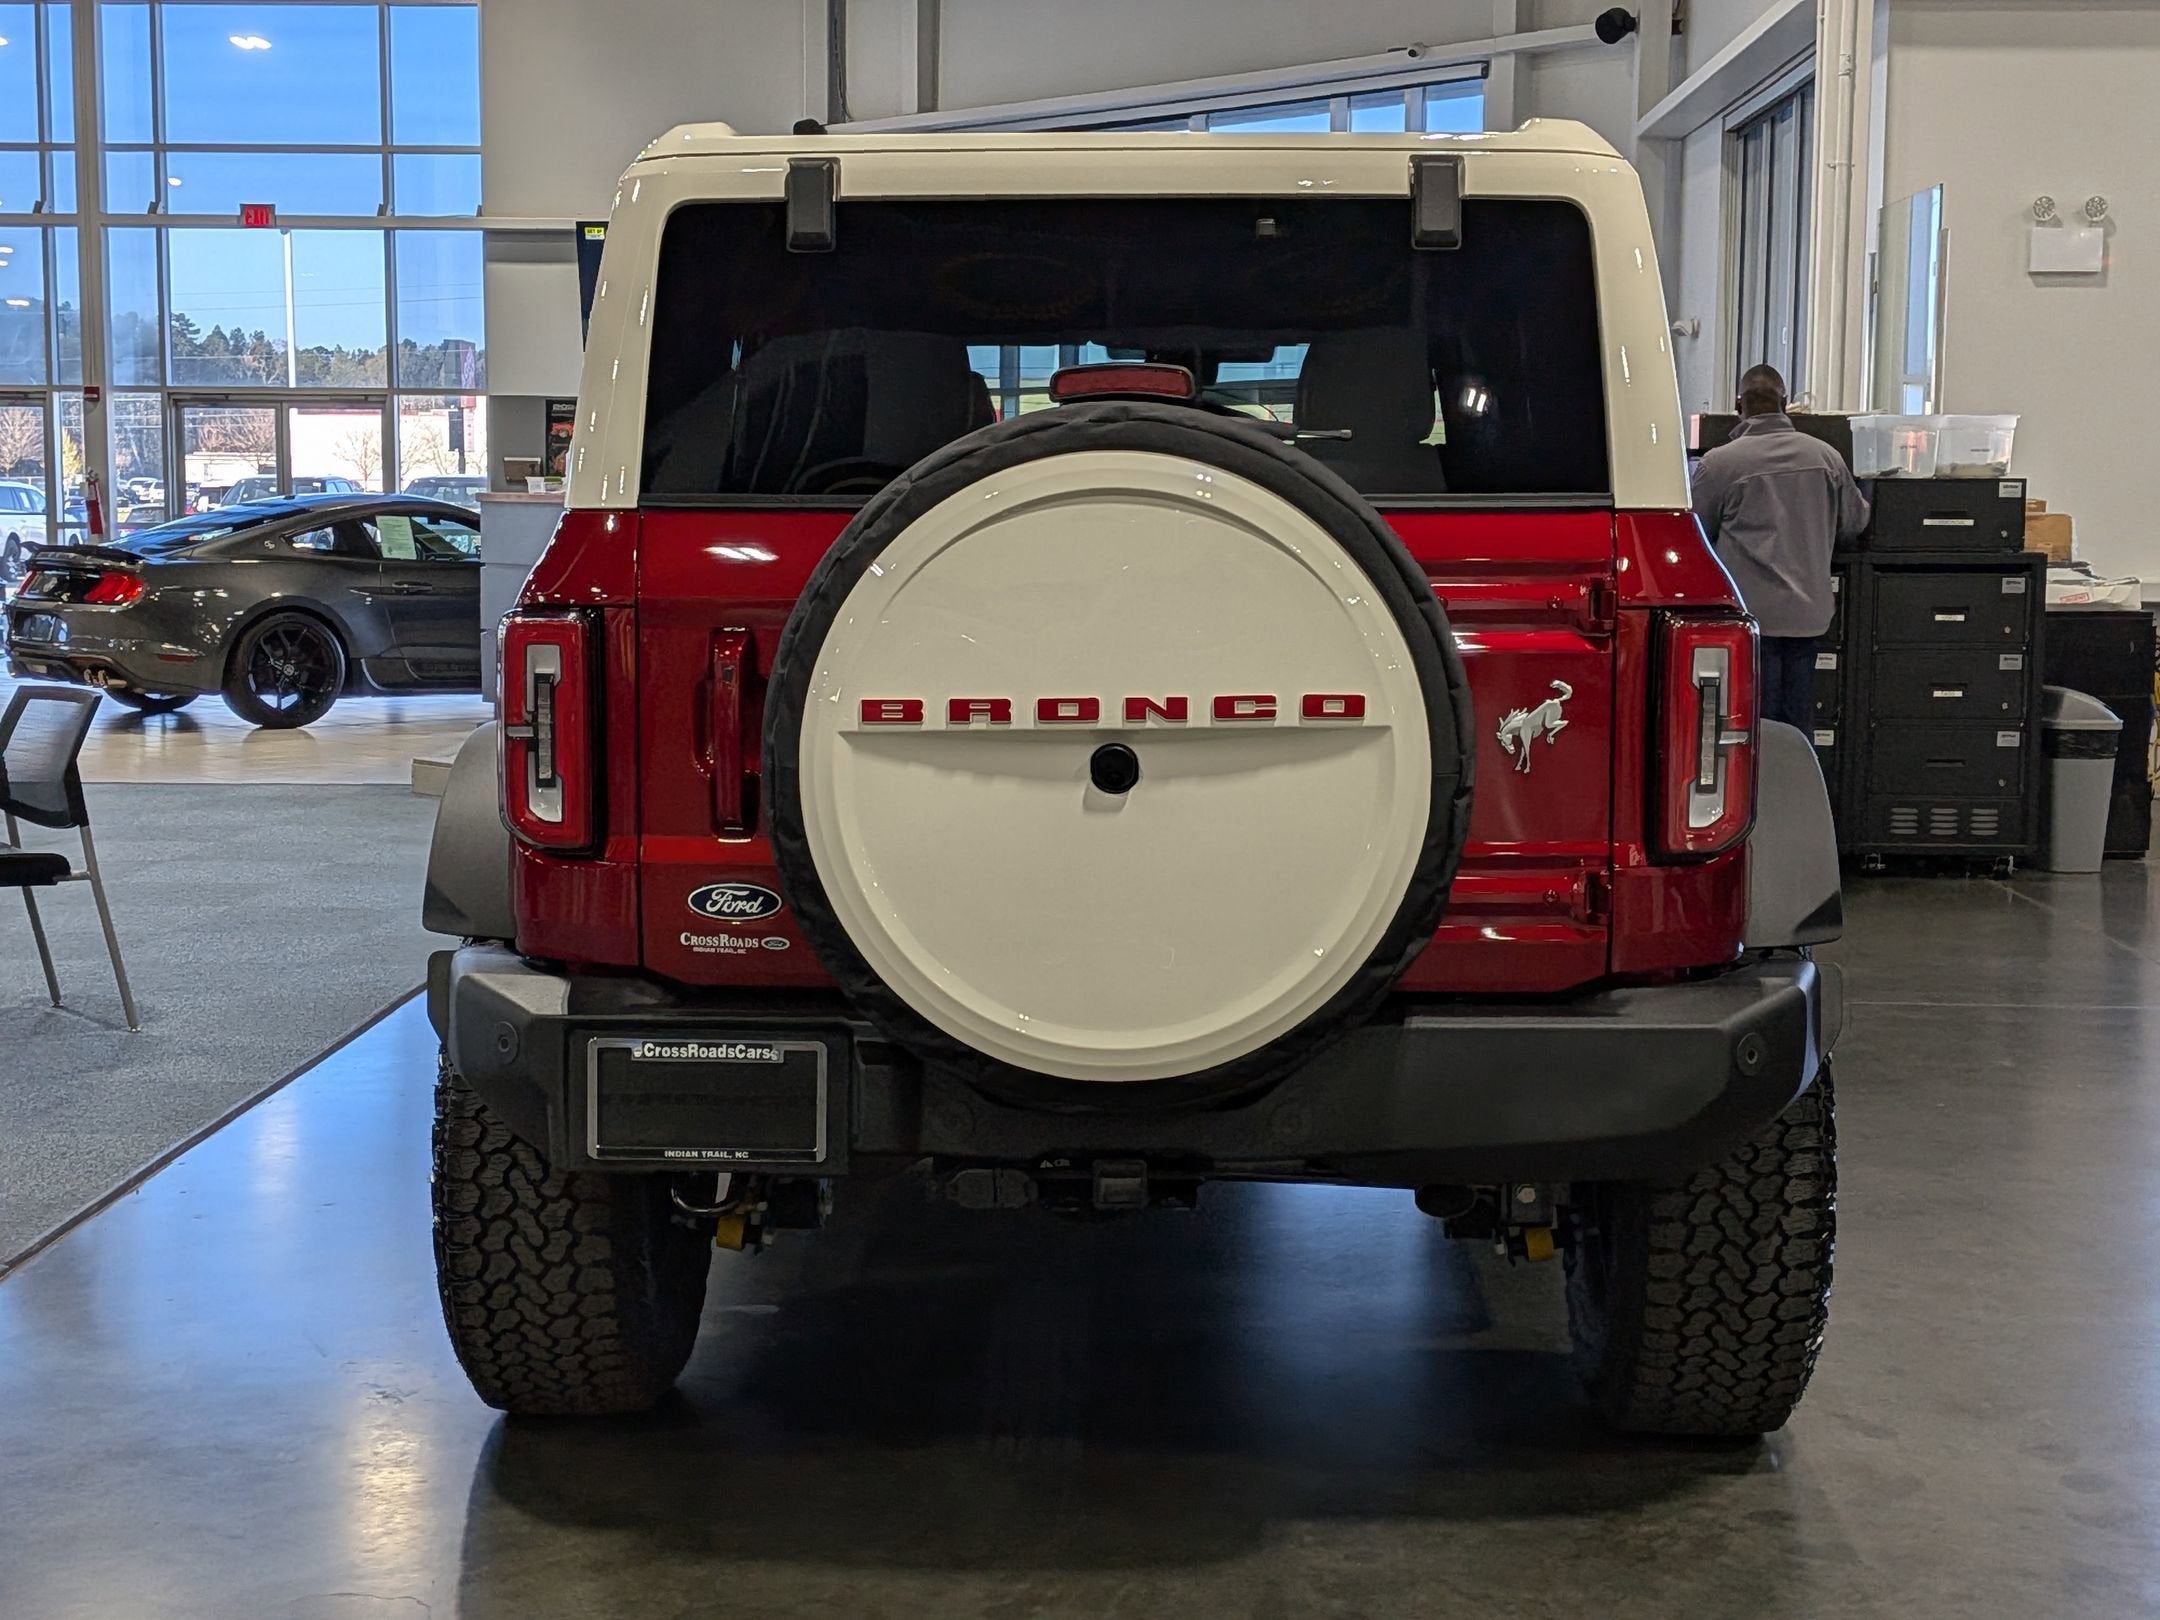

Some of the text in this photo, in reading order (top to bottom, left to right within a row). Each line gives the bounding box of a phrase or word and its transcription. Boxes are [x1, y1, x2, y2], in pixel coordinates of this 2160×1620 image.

[859, 694, 1366, 726] BRONCO
[705, 888, 765, 914] Ford
[664, 1150, 749, 1159] INDIAN TRAIL, NC
